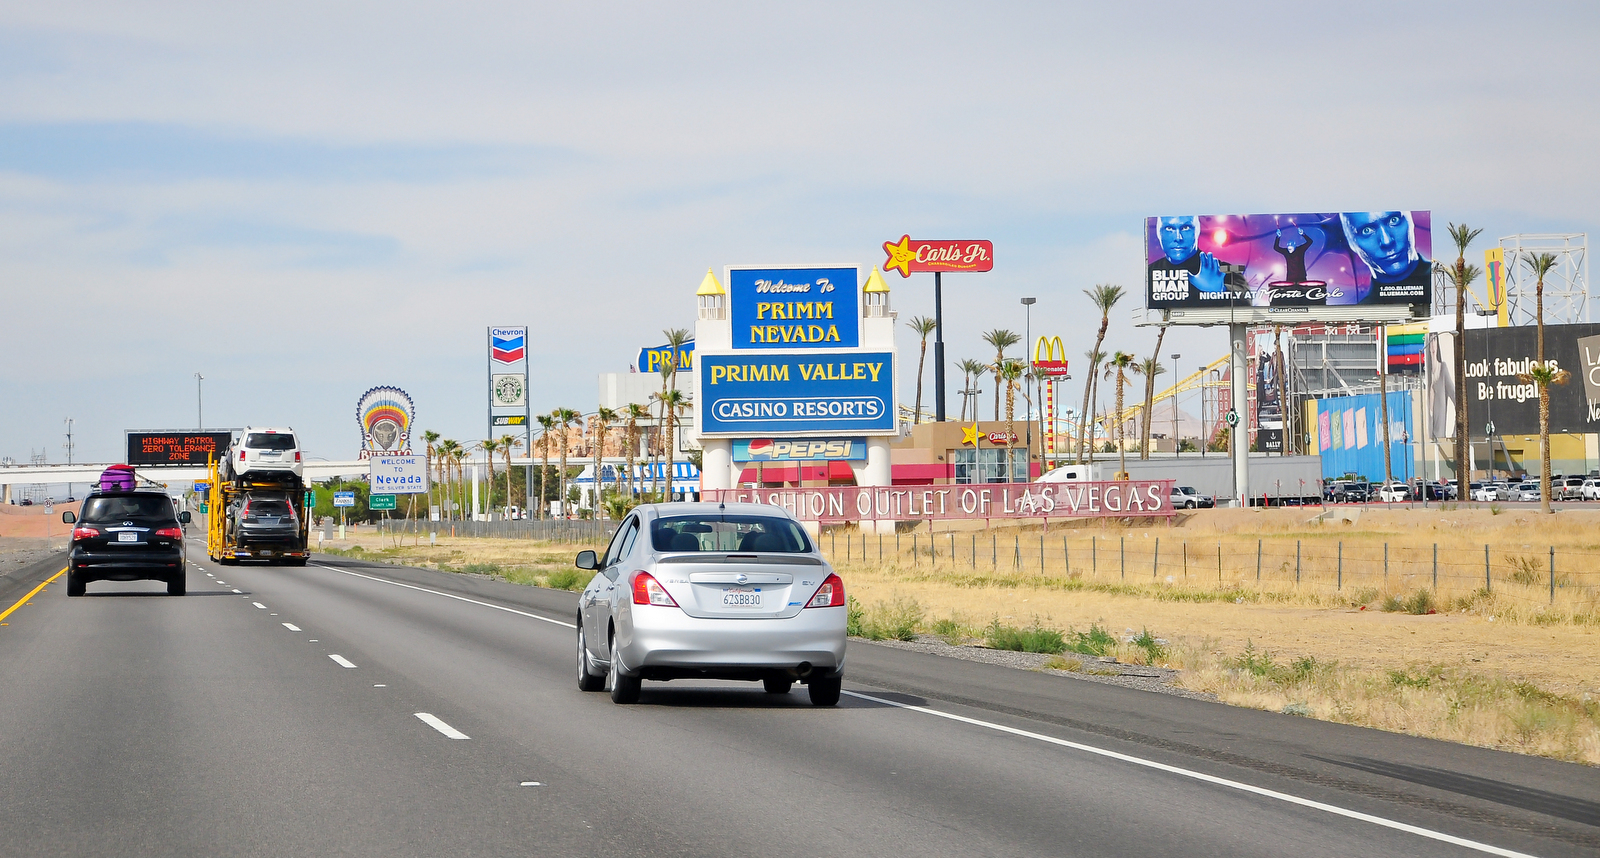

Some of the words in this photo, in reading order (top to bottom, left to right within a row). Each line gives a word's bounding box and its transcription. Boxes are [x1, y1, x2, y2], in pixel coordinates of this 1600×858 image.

[916, 244, 962, 263] Carl's
[963, 244, 990, 263] Jr.
[1152, 270, 1188, 280] BLUE
[755, 279, 810, 293] Welcome
[816, 278, 835, 294] To
[1152, 281, 1188, 292] MAN
[1152, 292, 1189, 300] GROUP
[1259, 288, 1305, 302] Monte
[1306, 288, 1344, 300] Carlo
[756, 302, 833, 320] PRIMM
[750, 324, 841, 343] NEVADA
[710, 365, 790, 384] PRIMM
[798, 363, 883, 382] VALLEY
[1464, 359, 1492, 378] Look
[1478, 382, 1494, 400] Be
[718, 402, 787, 417] CASINO
[793, 401, 878, 416] RESORTS
[494, 416, 524, 424] SUBWAY
[772, 440, 852, 458] PEPSI
[376, 475, 421, 484] Nevada
[857, 490, 950, 516] OUTLET
[962, 489, 991, 514] OF
[1004, 487, 1055, 513] LAS
[1066, 486, 1162, 512] VEGAS
[724, 594, 760, 604] 6ZSB830
